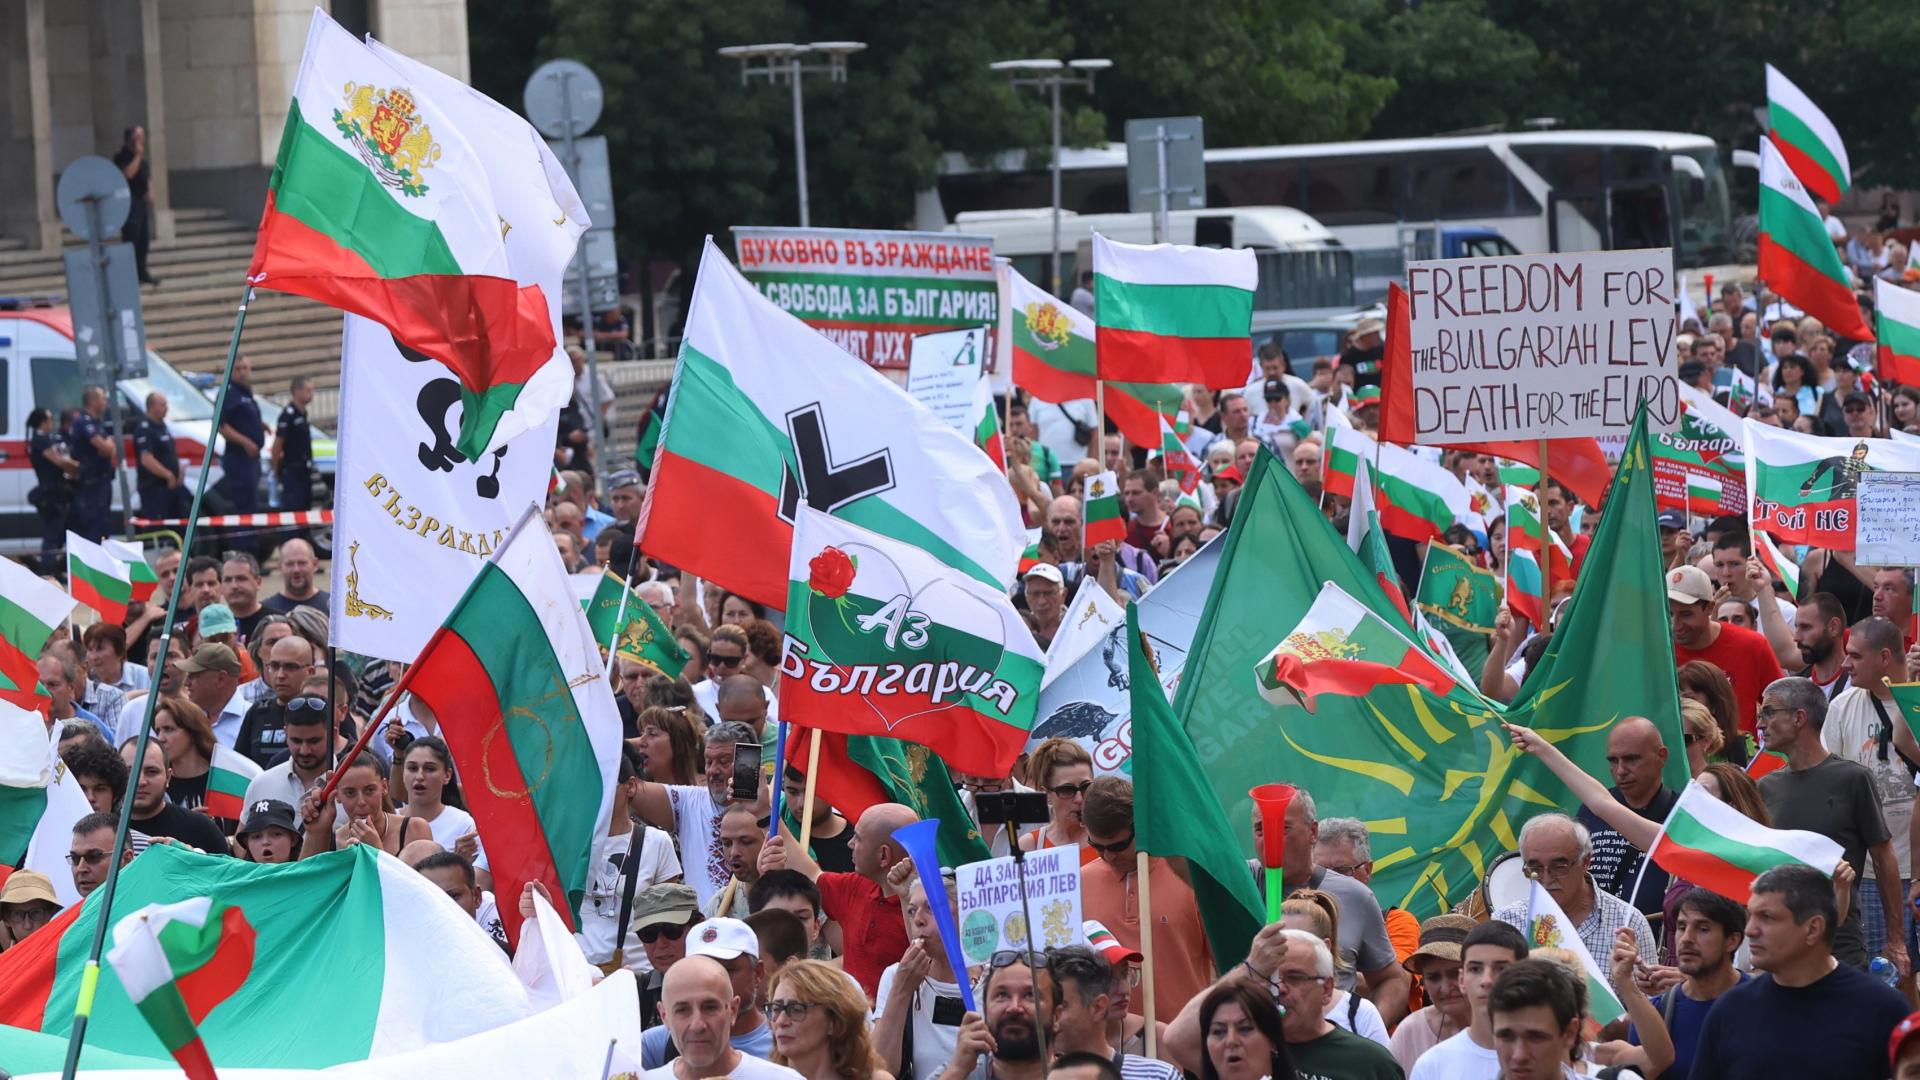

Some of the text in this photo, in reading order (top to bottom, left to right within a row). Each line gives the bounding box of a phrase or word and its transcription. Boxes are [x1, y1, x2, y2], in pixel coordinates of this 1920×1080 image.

[741, 239, 993, 274] ДУХОВНО ВЪЗРАЖДАНЕ
[766, 281, 852, 320] СВОБОДА
[857, 289, 880, 316] ЗА
[885, 288, 996, 321] БЪЛГАРИЯ!
[1409, 263, 1671, 320] FREEDOM FOR
[872, 332, 905, 364] ДУХ
[1411, 346, 1437, 374] THE
[1608, 318, 1675, 368] LEV
[1414, 374, 1679, 435] DEATH FOR THE EURO
[1755, 496, 1806, 530] Той
[856, 593, 933, 650] Аз
[780, 632, 1019, 715] България
[974, 865, 993, 888] ДА
[1048, 873, 1077, 895] ЛЕВ
